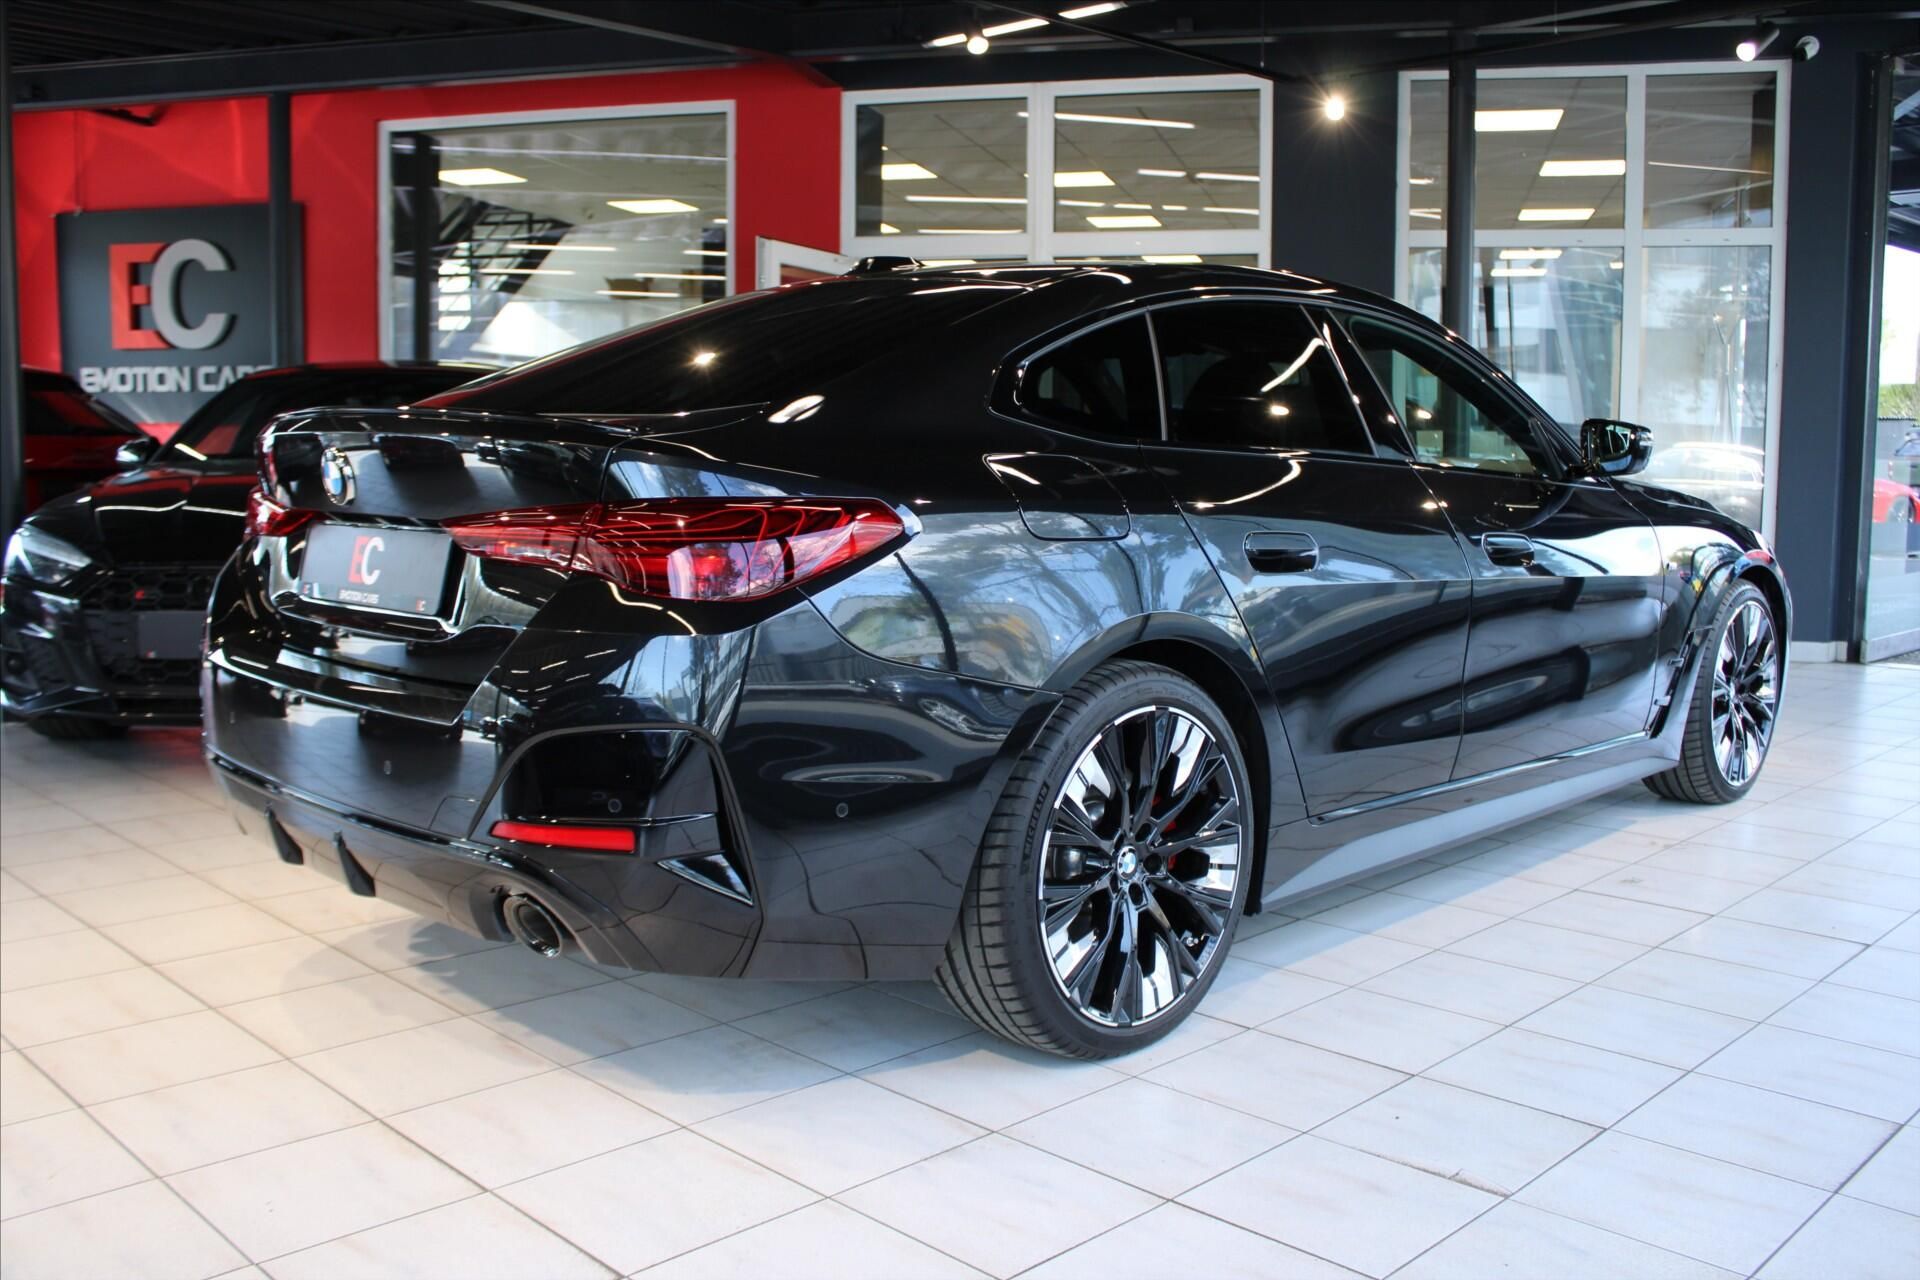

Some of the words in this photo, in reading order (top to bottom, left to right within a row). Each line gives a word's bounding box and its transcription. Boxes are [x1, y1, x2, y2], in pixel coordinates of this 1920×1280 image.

[109, 239, 231, 350] EC
[80, 366, 191, 393] EMOTION
[197, 365, 273, 392] CAR
[348, 536, 385, 585] EC
[1023, 781, 1049, 857] MICHELIN
